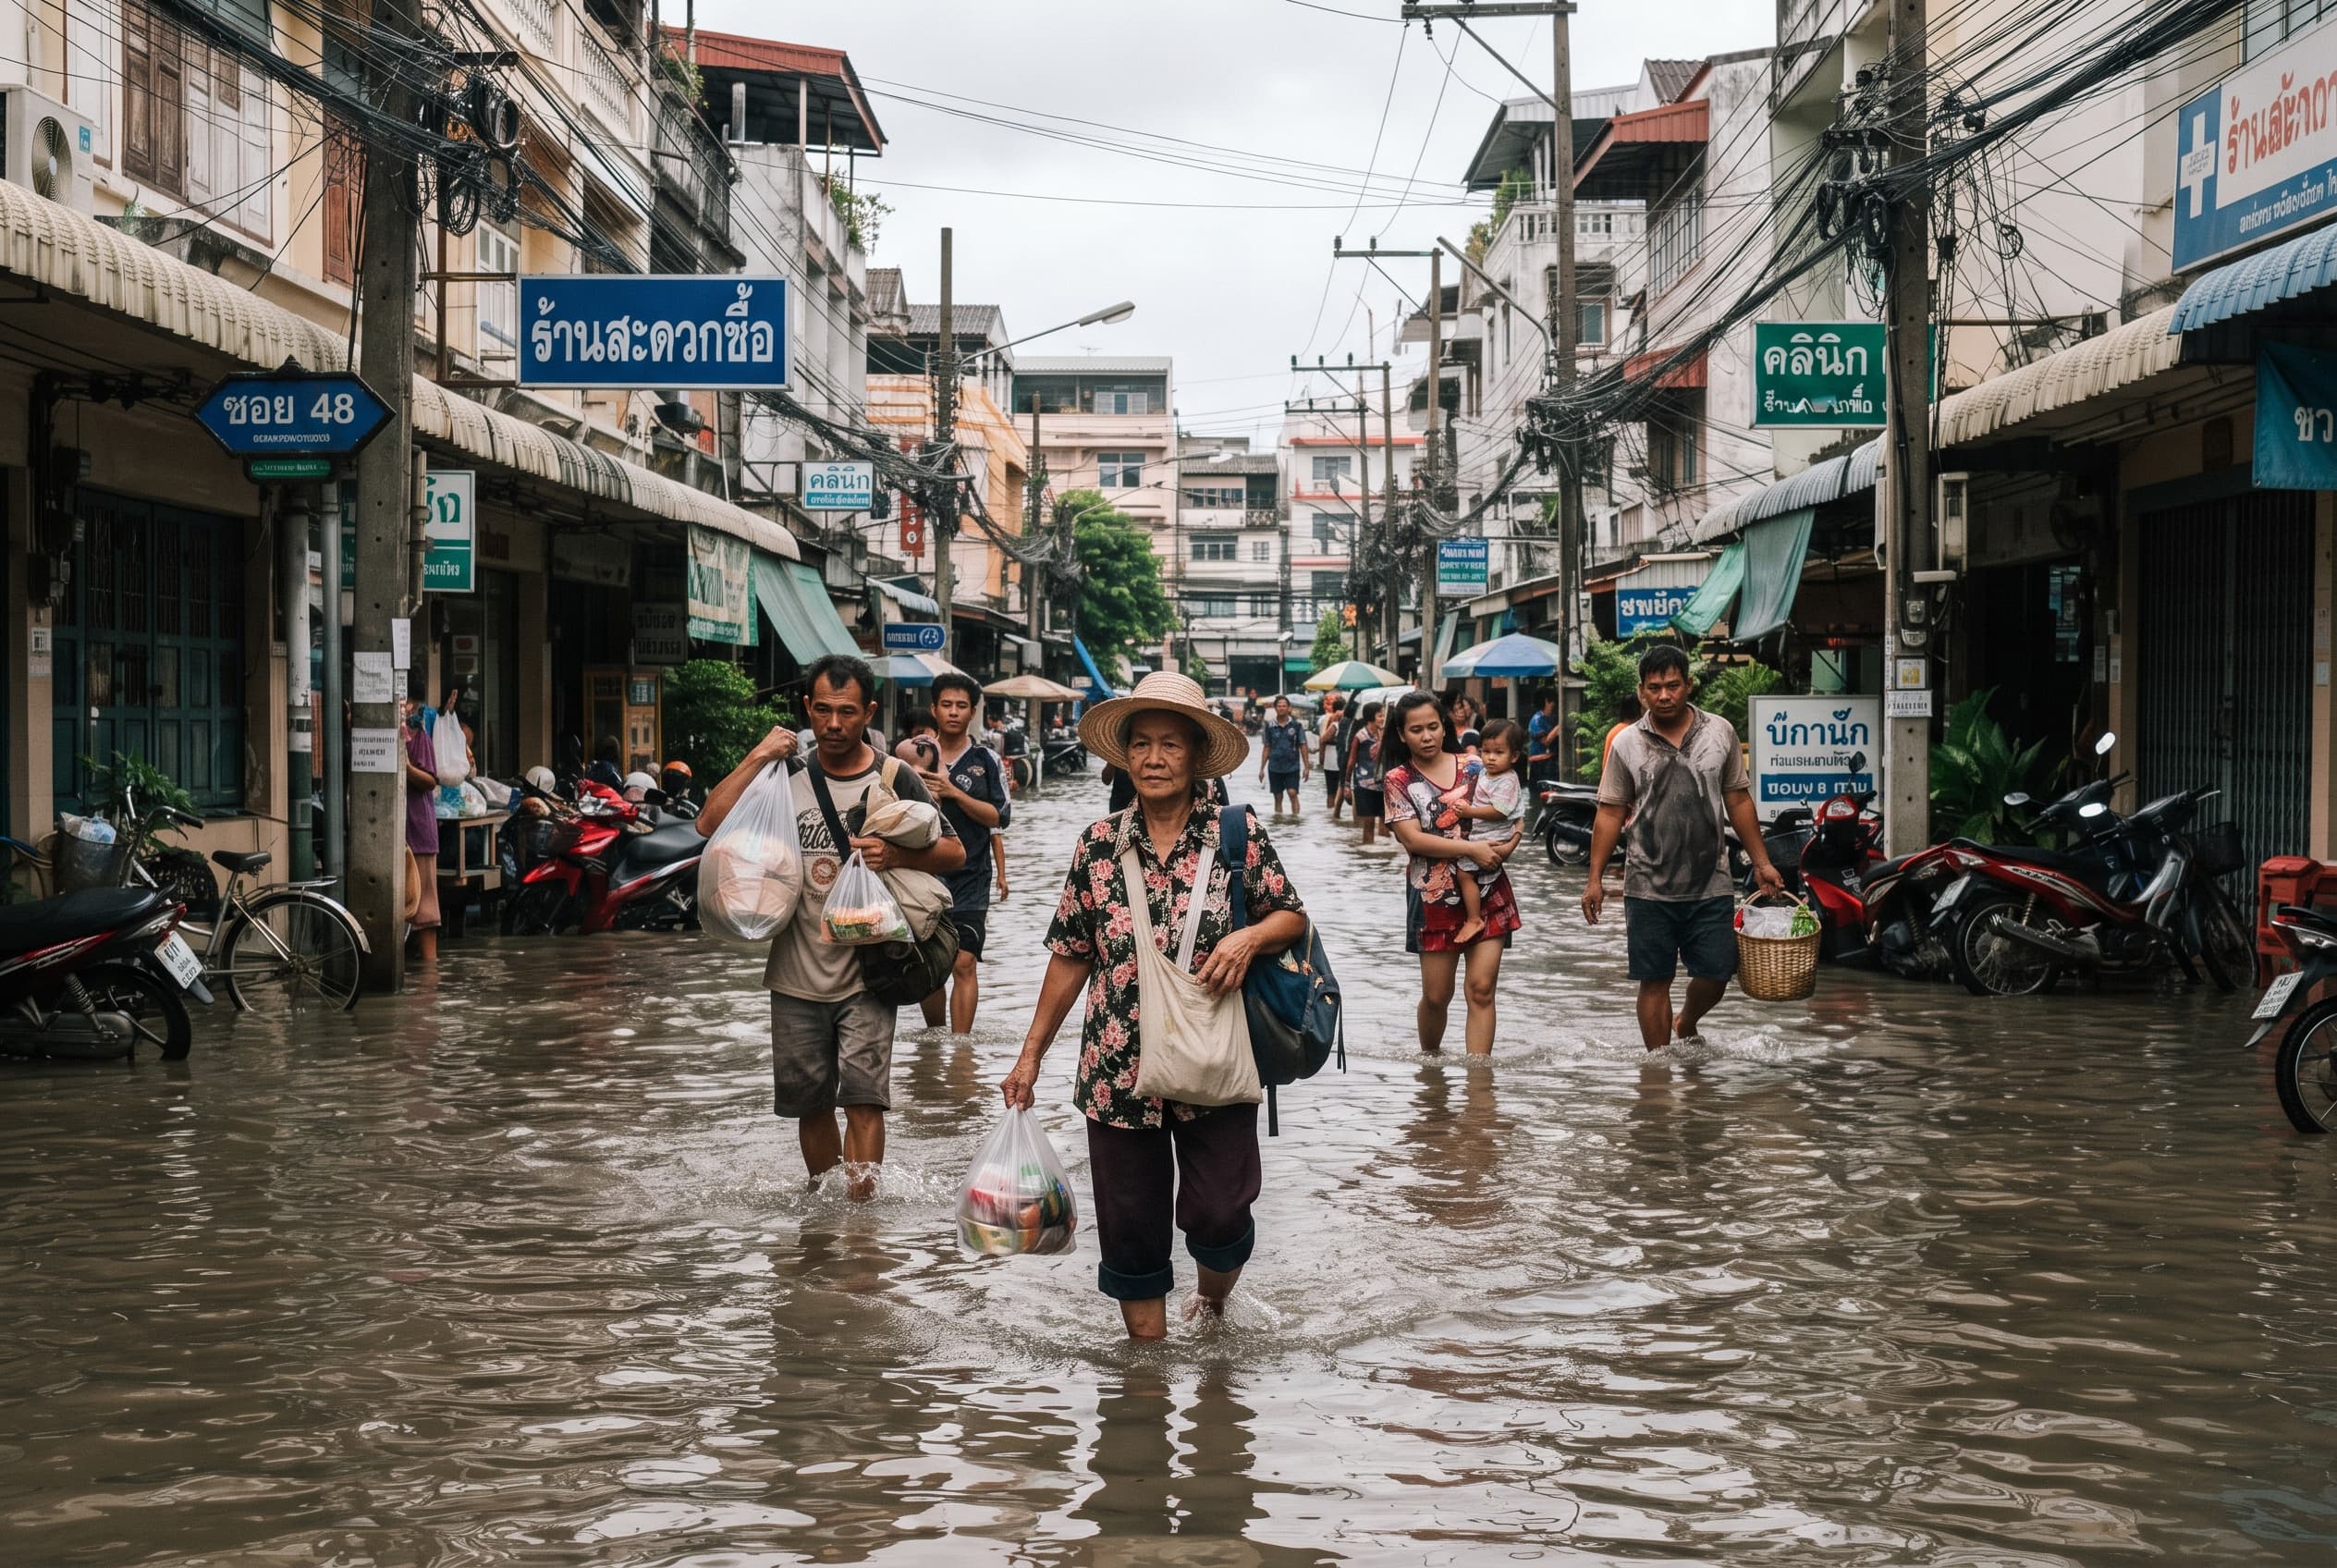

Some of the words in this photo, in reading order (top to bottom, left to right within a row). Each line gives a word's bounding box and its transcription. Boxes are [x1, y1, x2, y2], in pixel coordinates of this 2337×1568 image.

[1764, 332, 1867, 375] คลินิก
[310, 393, 355, 424] 48
[810, 465, 870, 490] คลินิก
